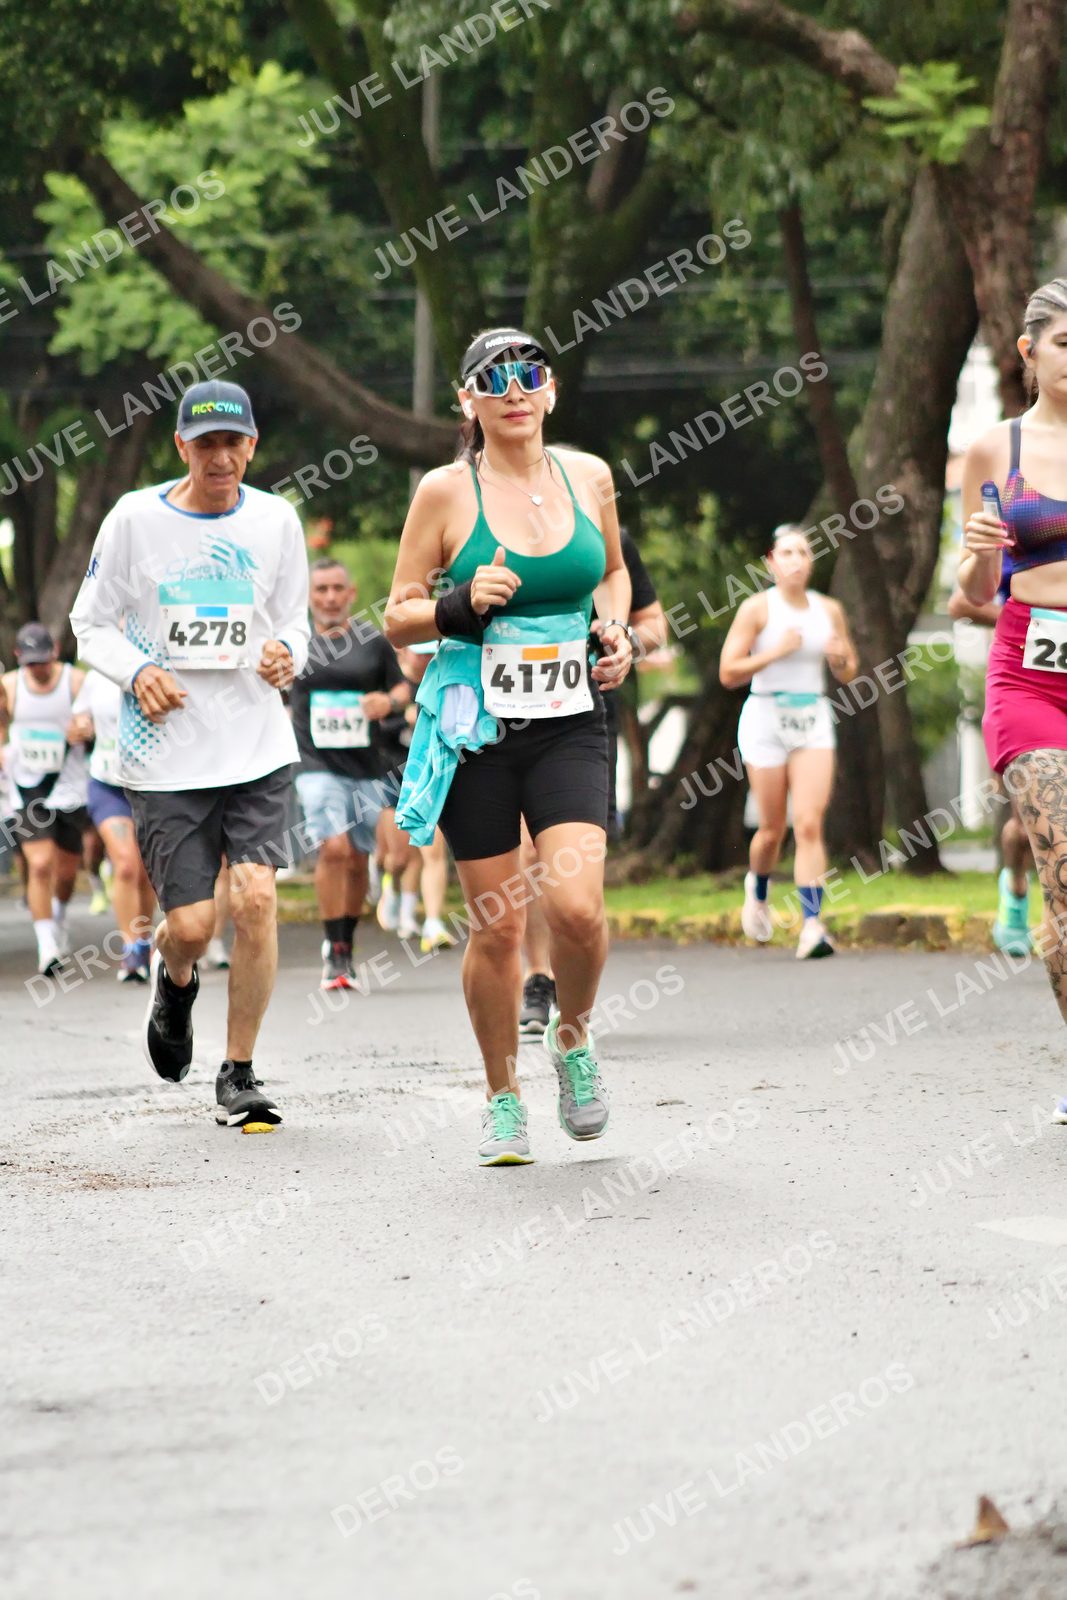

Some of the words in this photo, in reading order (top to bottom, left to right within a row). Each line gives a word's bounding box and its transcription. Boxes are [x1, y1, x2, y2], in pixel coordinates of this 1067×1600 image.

[168, 621, 246, 646] 4278
[490, 660, 581, 693] 4170
[317, 718, 363, 733] 5847
